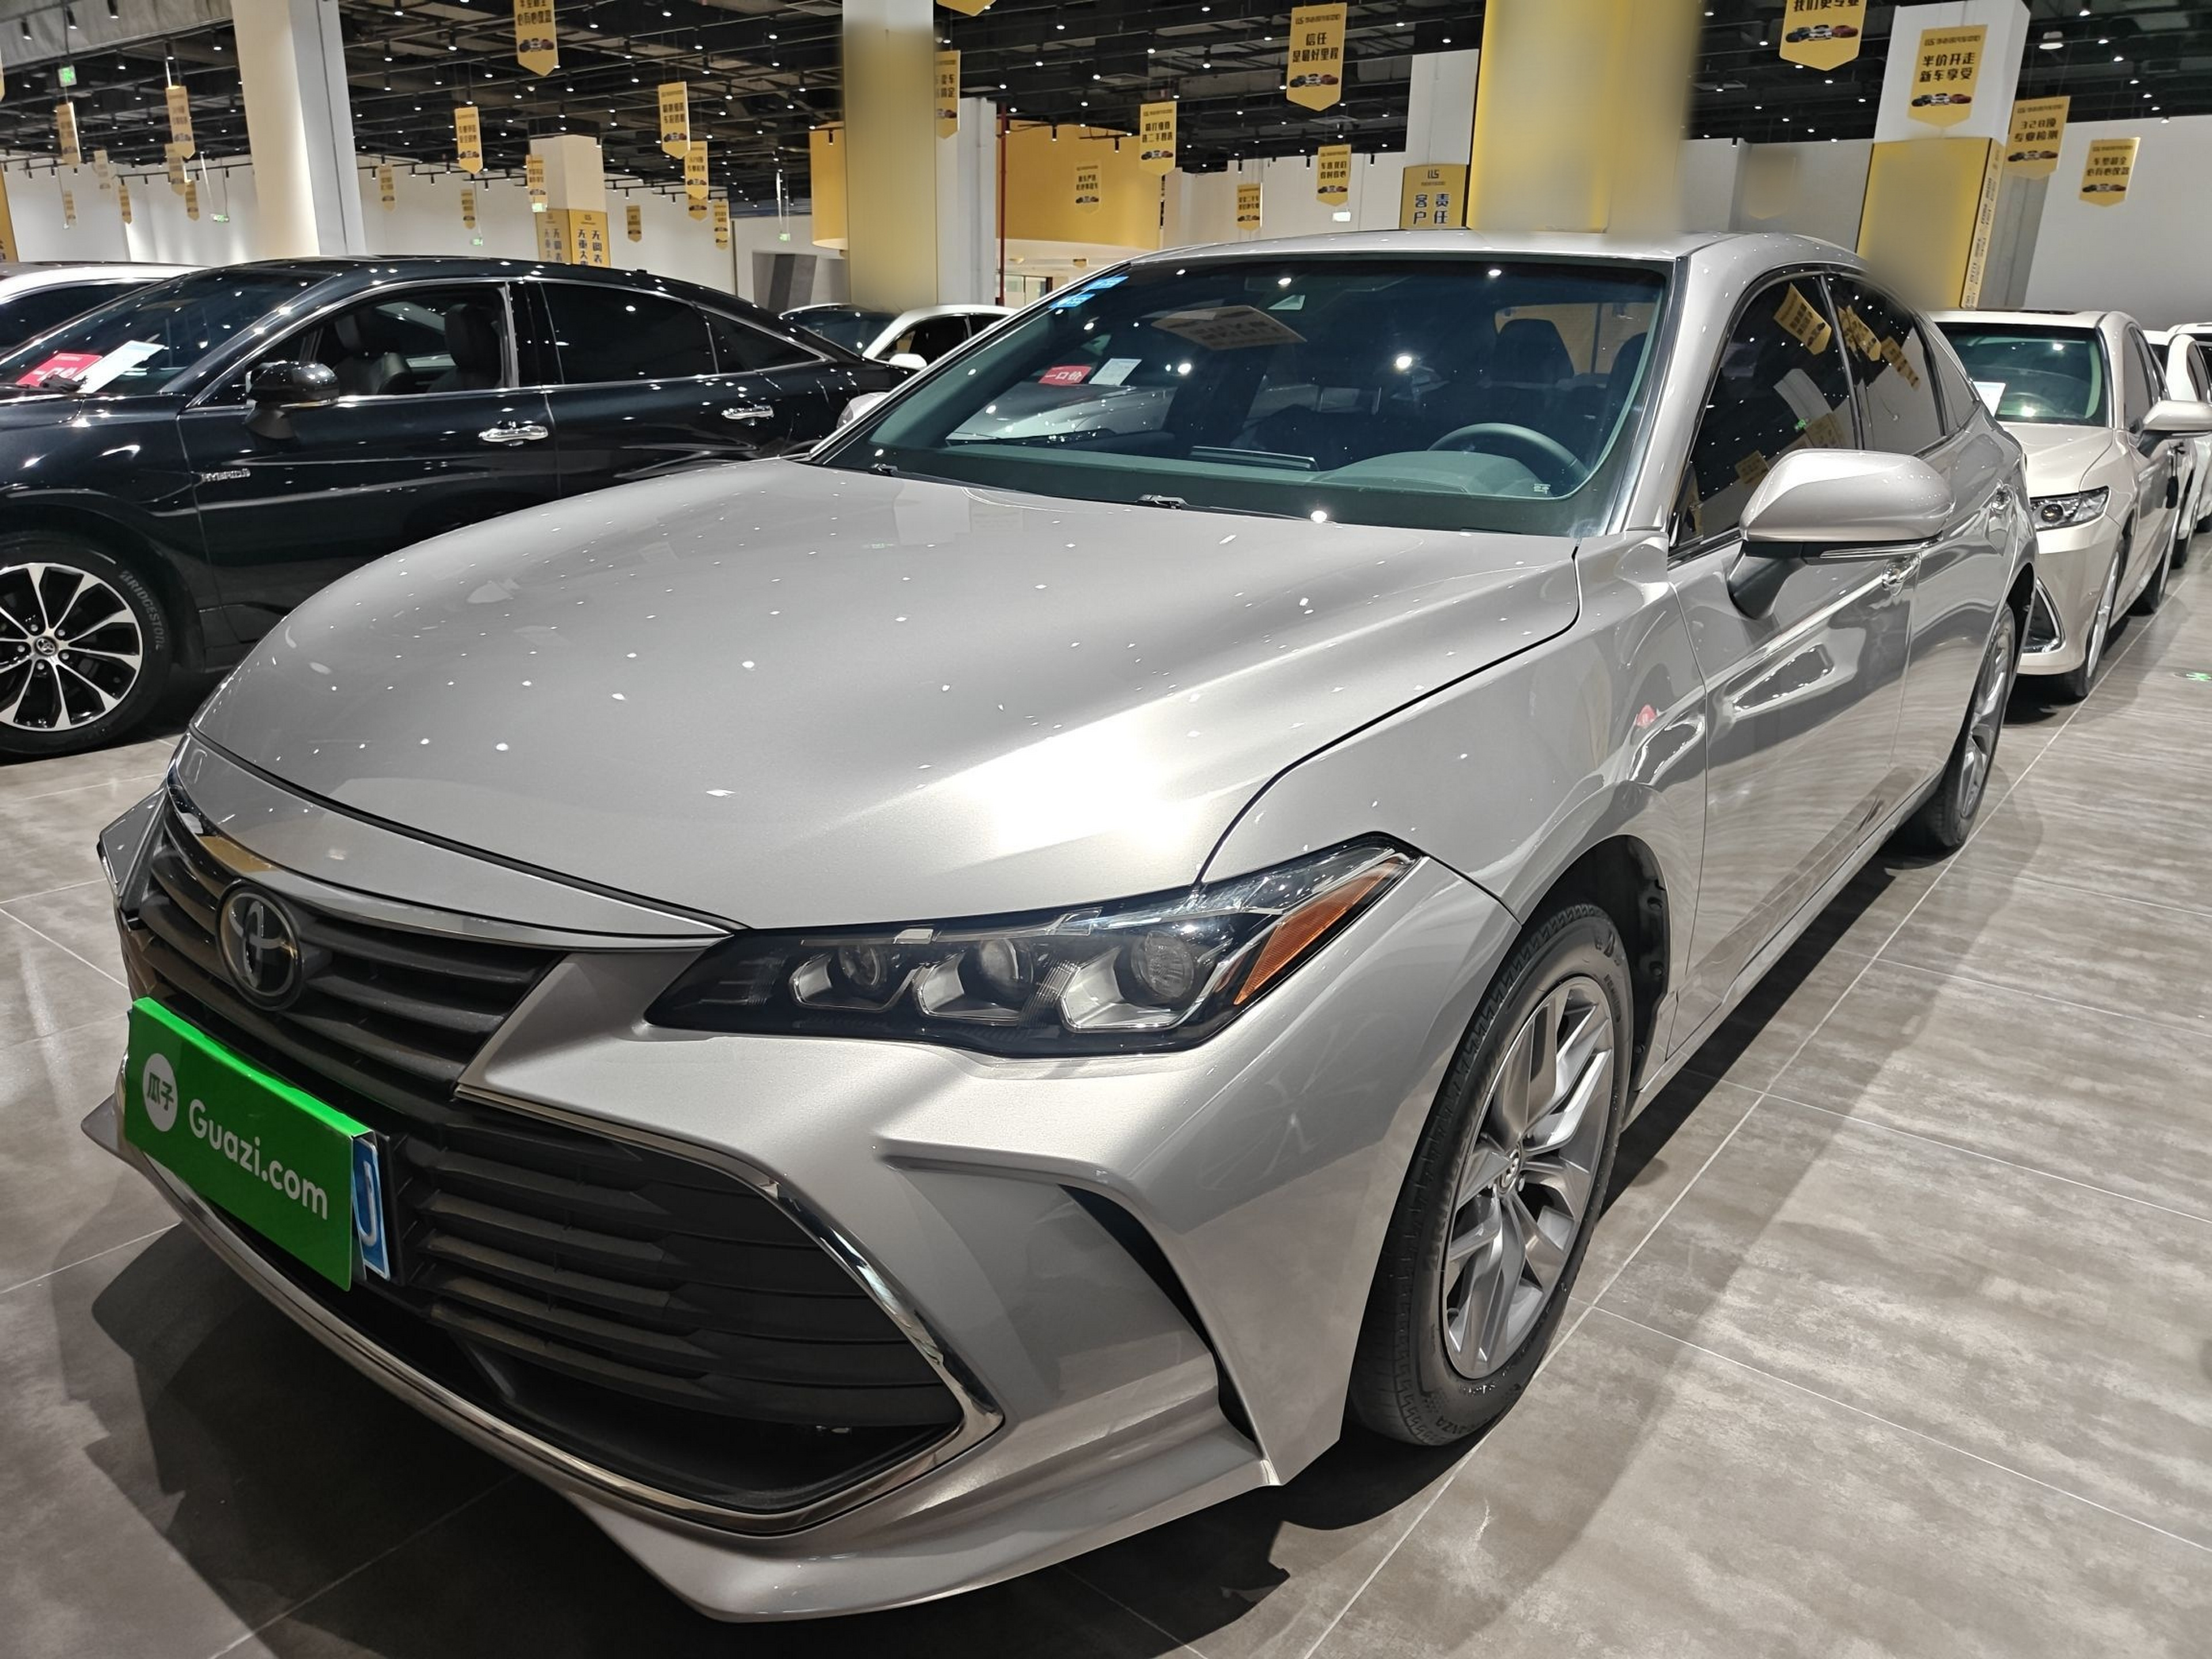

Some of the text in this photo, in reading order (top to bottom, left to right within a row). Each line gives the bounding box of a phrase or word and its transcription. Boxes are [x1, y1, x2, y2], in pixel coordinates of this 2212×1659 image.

[1306, 32, 1327, 46] 信任
[1923, 52, 1975, 67] 半价开走
[1413, 194, 1428, 225] 客户
[1434, 194, 1449, 225] 责任
[1044, 371, 1082, 381] 一口价
[147, 1072, 174, 1111] 瓜子
[189, 1099, 328, 1220] Guazi.com
